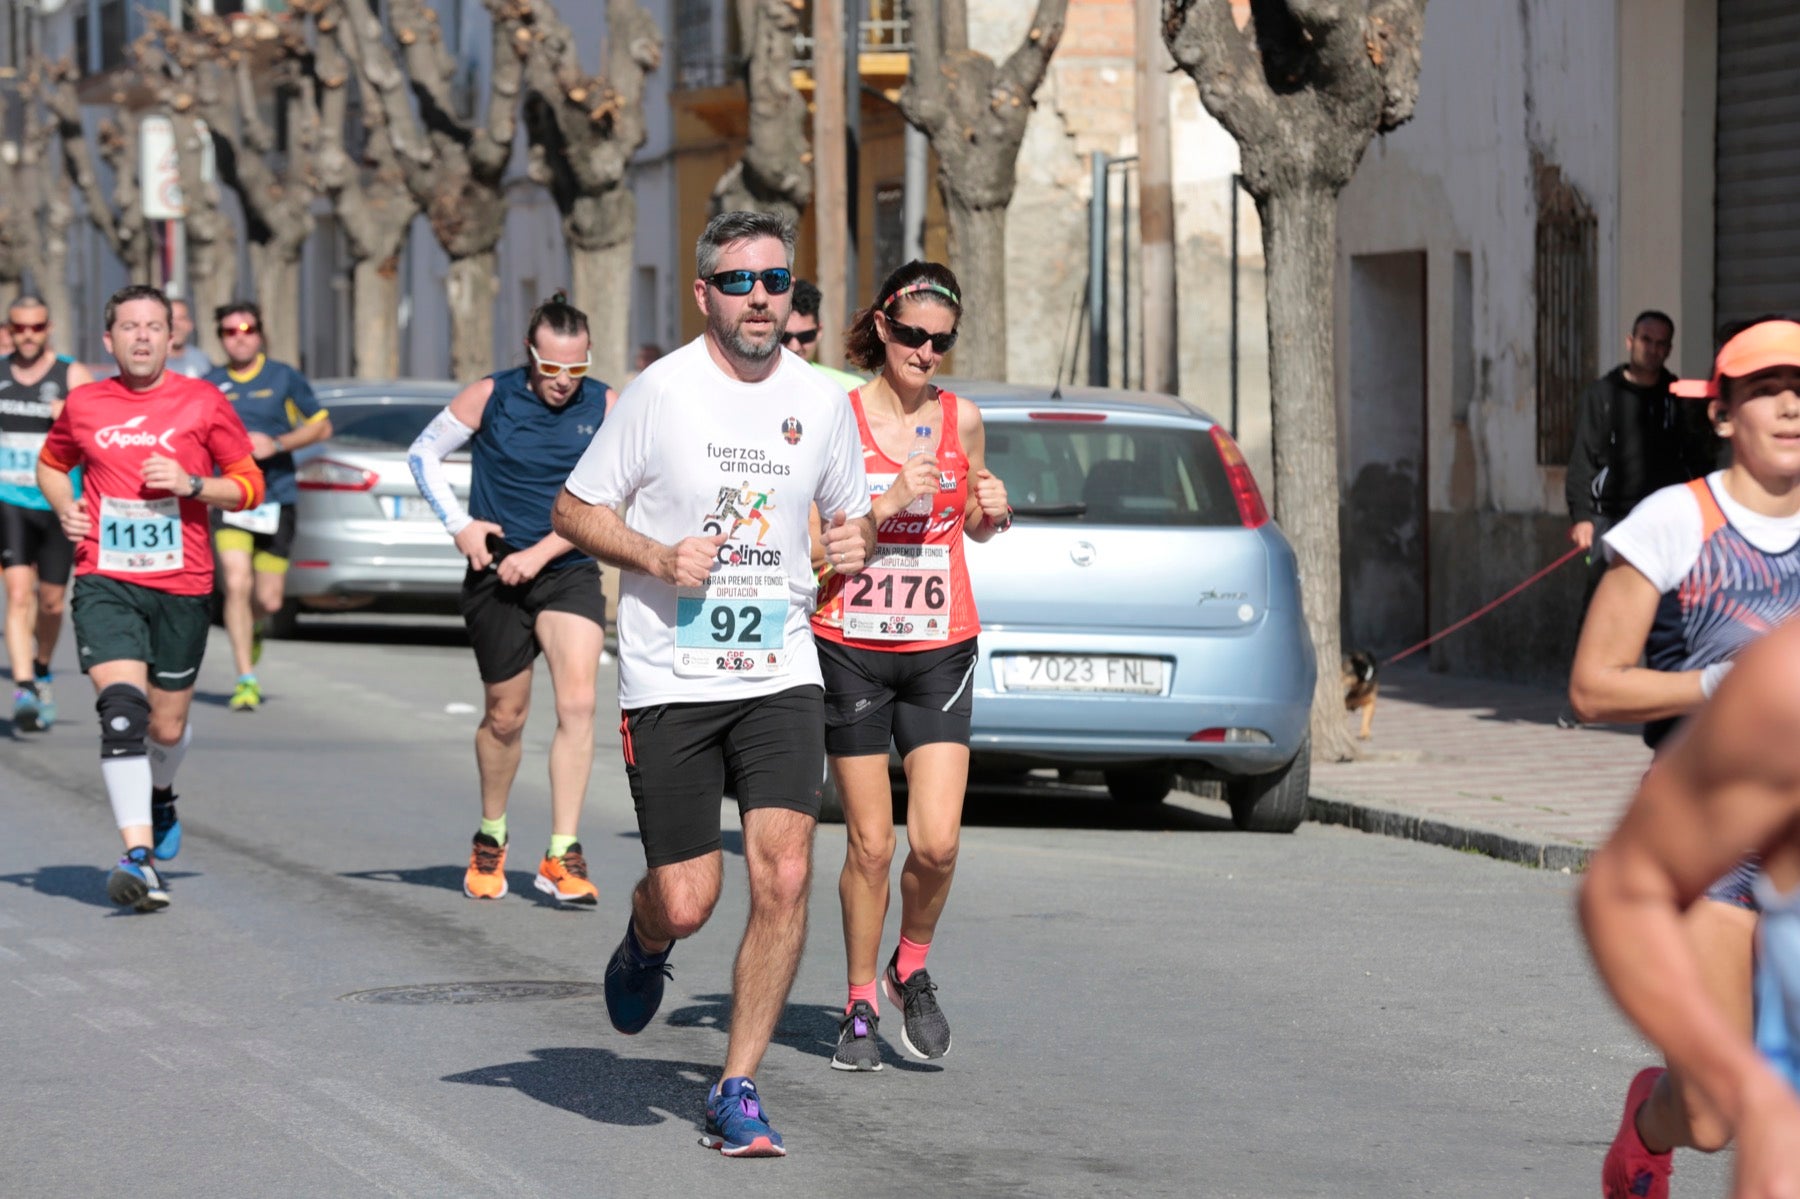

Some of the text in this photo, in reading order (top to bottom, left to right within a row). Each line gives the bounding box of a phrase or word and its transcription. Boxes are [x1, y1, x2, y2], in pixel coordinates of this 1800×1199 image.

[109, 430, 157, 449] Apolo
[707, 443, 766, 460] fuerzas
[720, 460, 790, 476] armadas
[107, 521, 173, 548] 1131
[728, 576, 753, 585] PREMIO
[755, 577, 763, 586] DE
[764, 577, 783, 586] FONDO
[850, 573, 945, 610] 2176
[711, 606, 762, 643] 92
[1030, 656, 1154, 685] 7023 FNL
